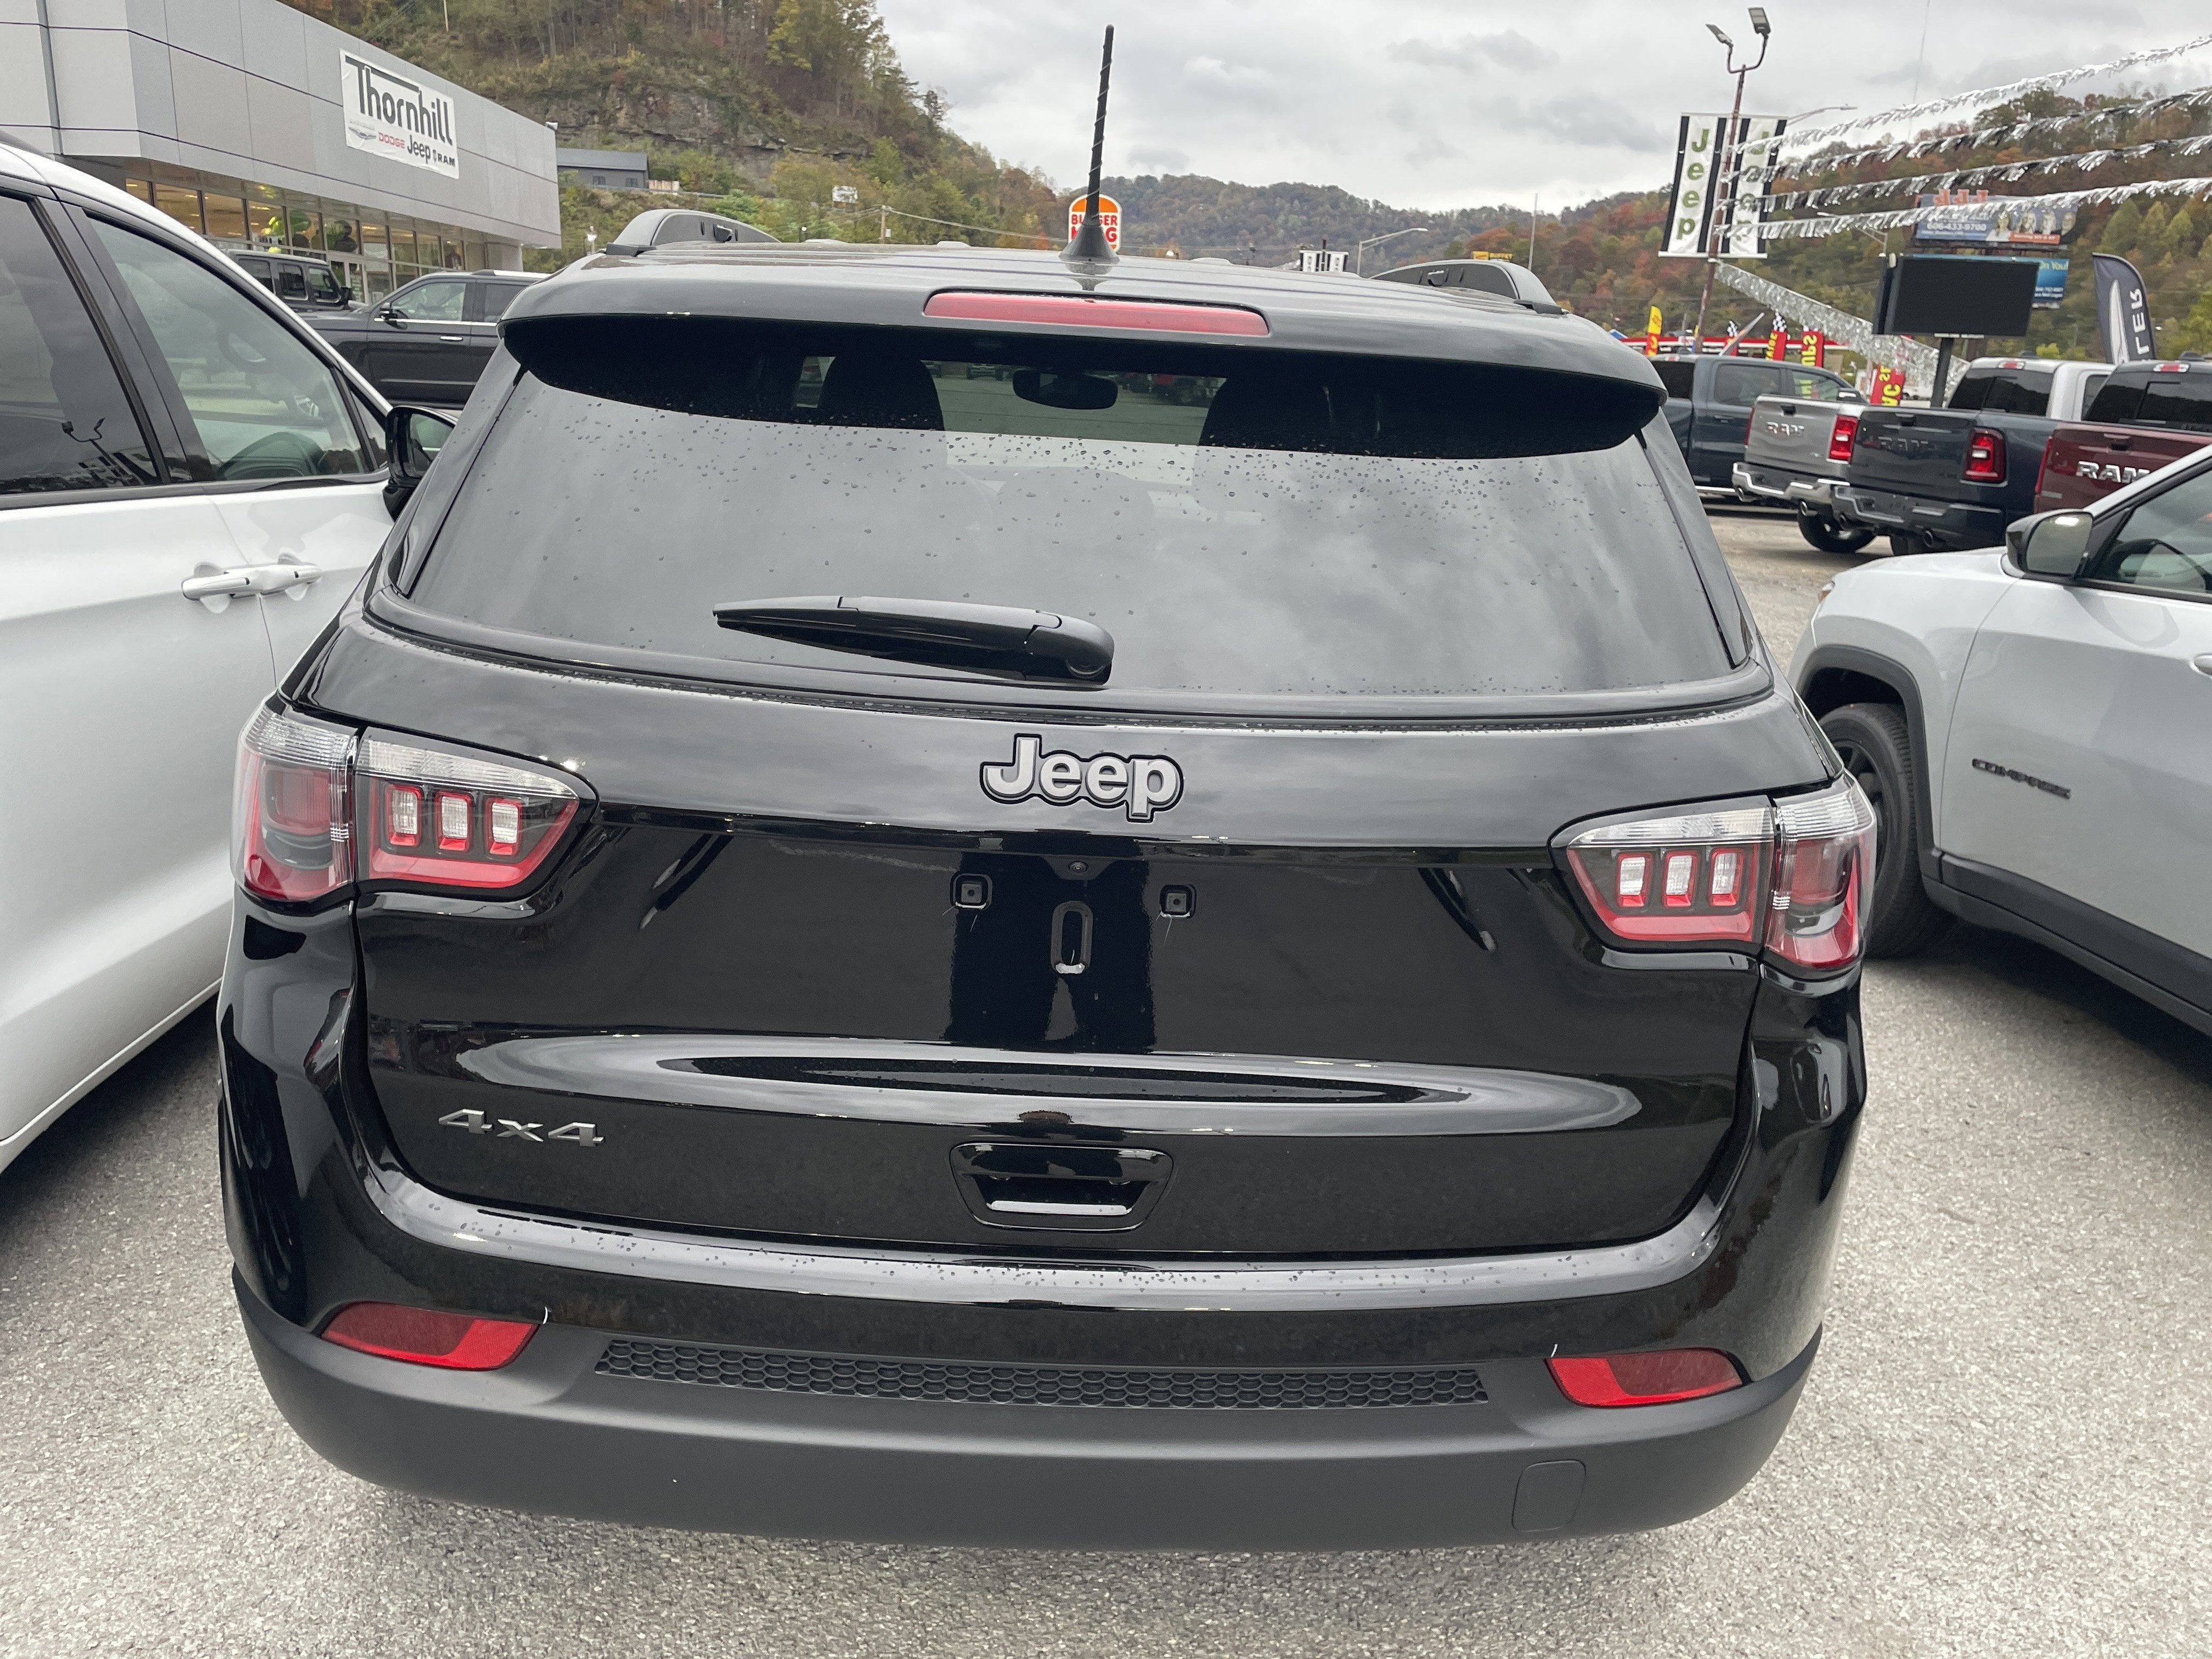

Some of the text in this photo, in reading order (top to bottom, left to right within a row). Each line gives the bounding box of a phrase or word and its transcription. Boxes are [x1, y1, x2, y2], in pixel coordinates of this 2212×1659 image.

[345, 55, 453, 146] Thornhill
[379, 132, 455, 166] DODGE Jeep RAM
[1677, 129, 1710, 240] Jeep
[980, 733, 1184, 823] Jeep
